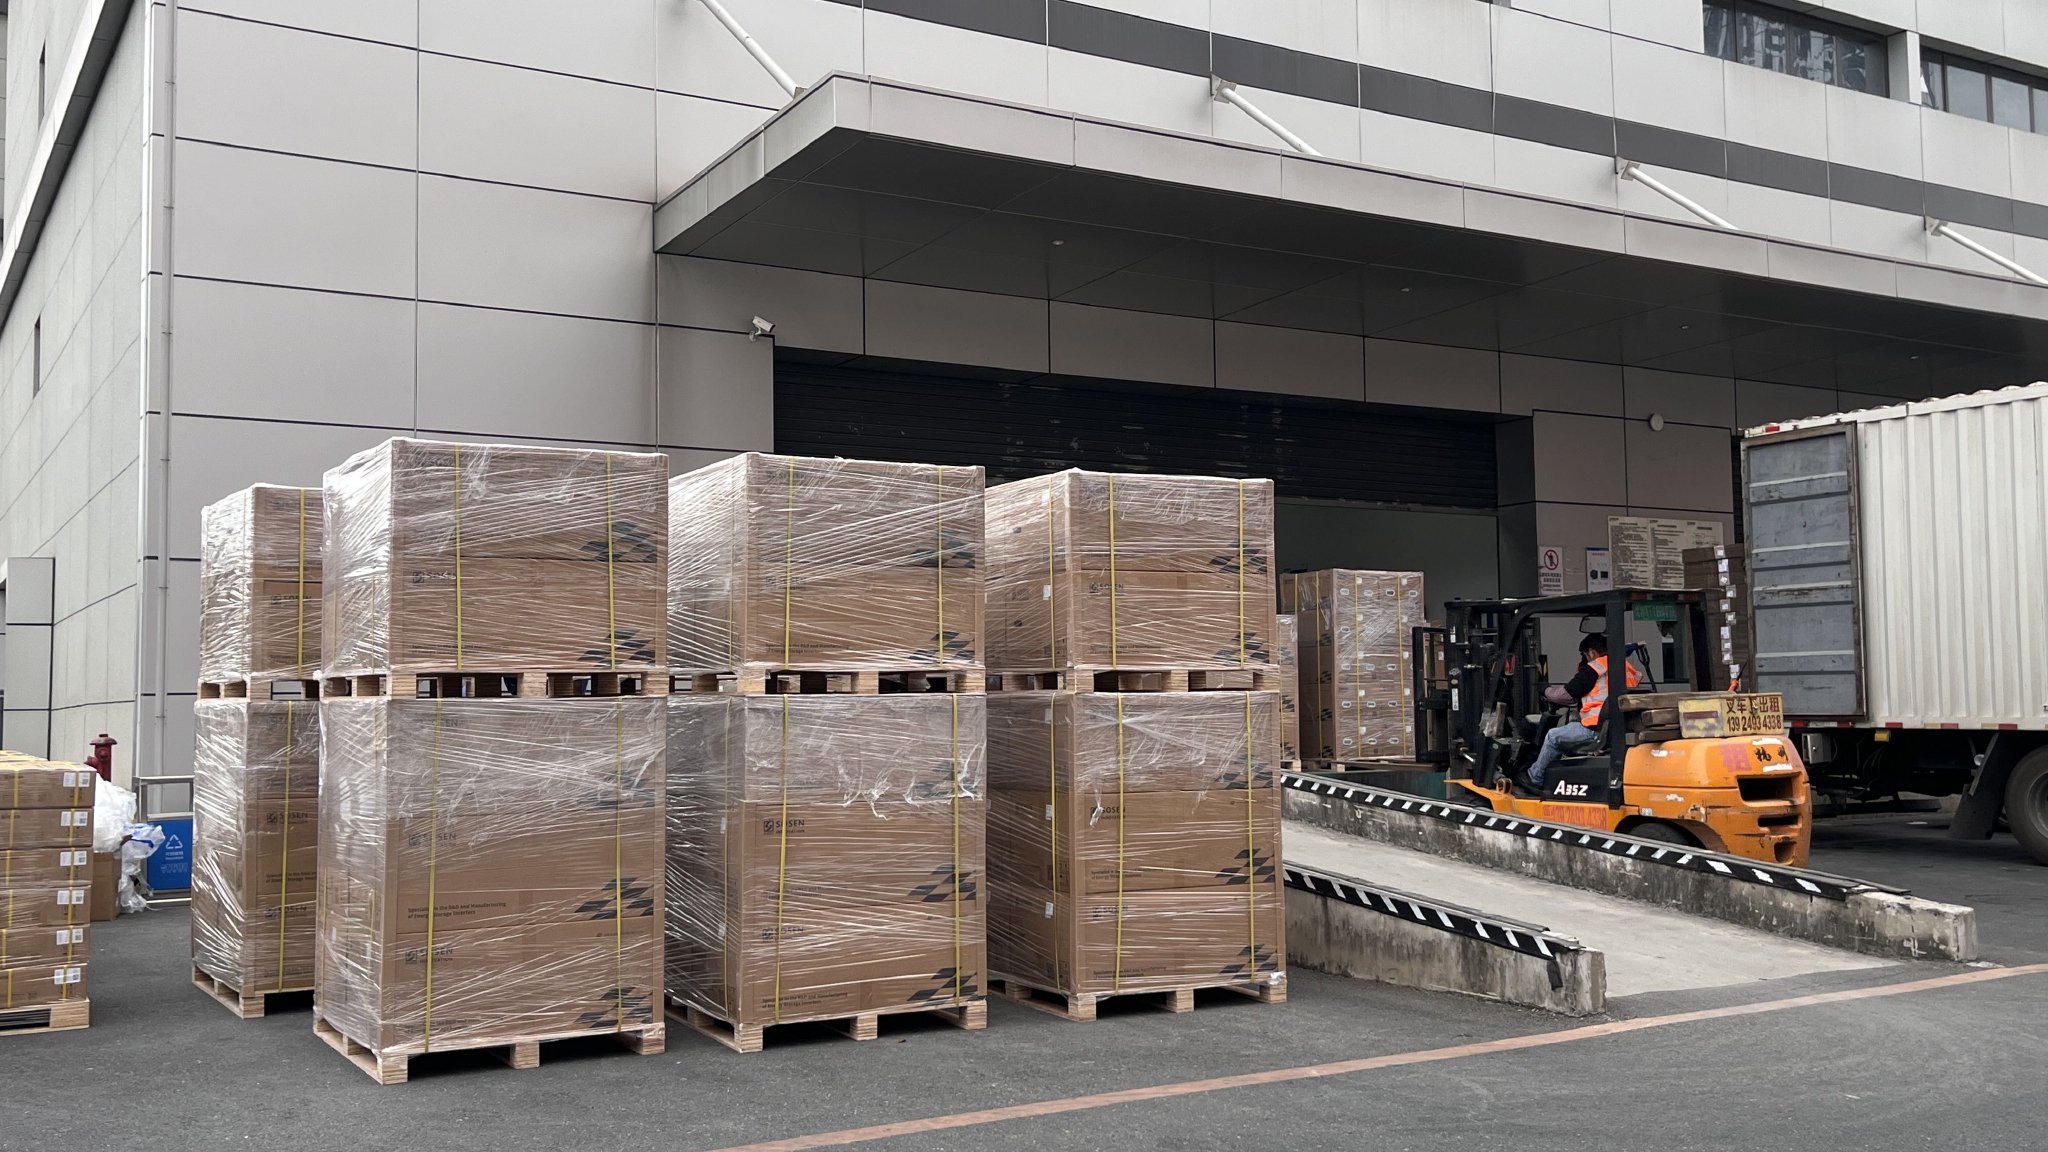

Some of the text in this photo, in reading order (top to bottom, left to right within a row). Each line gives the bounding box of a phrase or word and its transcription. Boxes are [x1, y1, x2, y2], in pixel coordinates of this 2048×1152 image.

[1727, 714, 1782, 732] 139 2493 4338
[1553, 780, 1589, 796] A35Z
